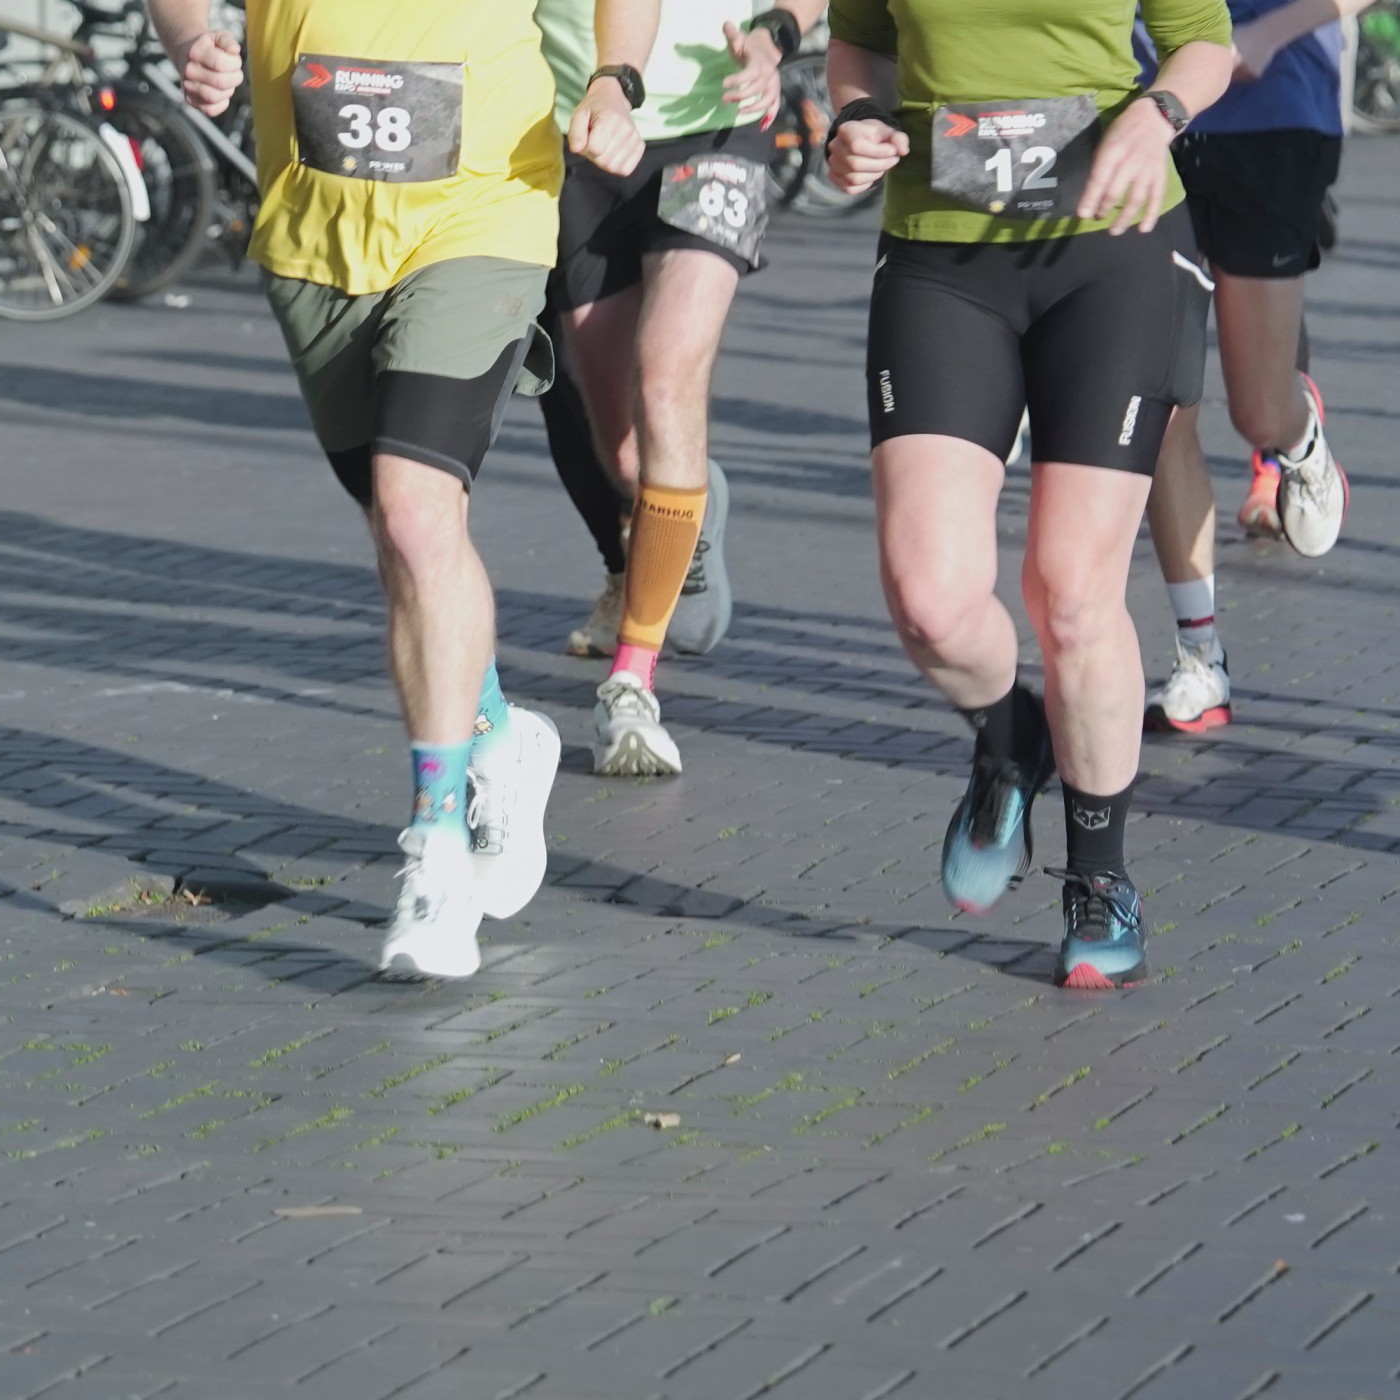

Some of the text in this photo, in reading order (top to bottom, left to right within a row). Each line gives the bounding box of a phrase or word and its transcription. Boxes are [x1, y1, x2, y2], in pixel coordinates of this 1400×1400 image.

[335, 70, 404, 89] RUNNING
[337, 104, 412, 151] 38
[978, 113, 1046, 129] RUNNING
[985, 146, 1058, 192] 12
[699, 180, 749, 228] 63
[879, 369, 896, 413] FUSION
[1118, 395, 1142, 446] FUSION
